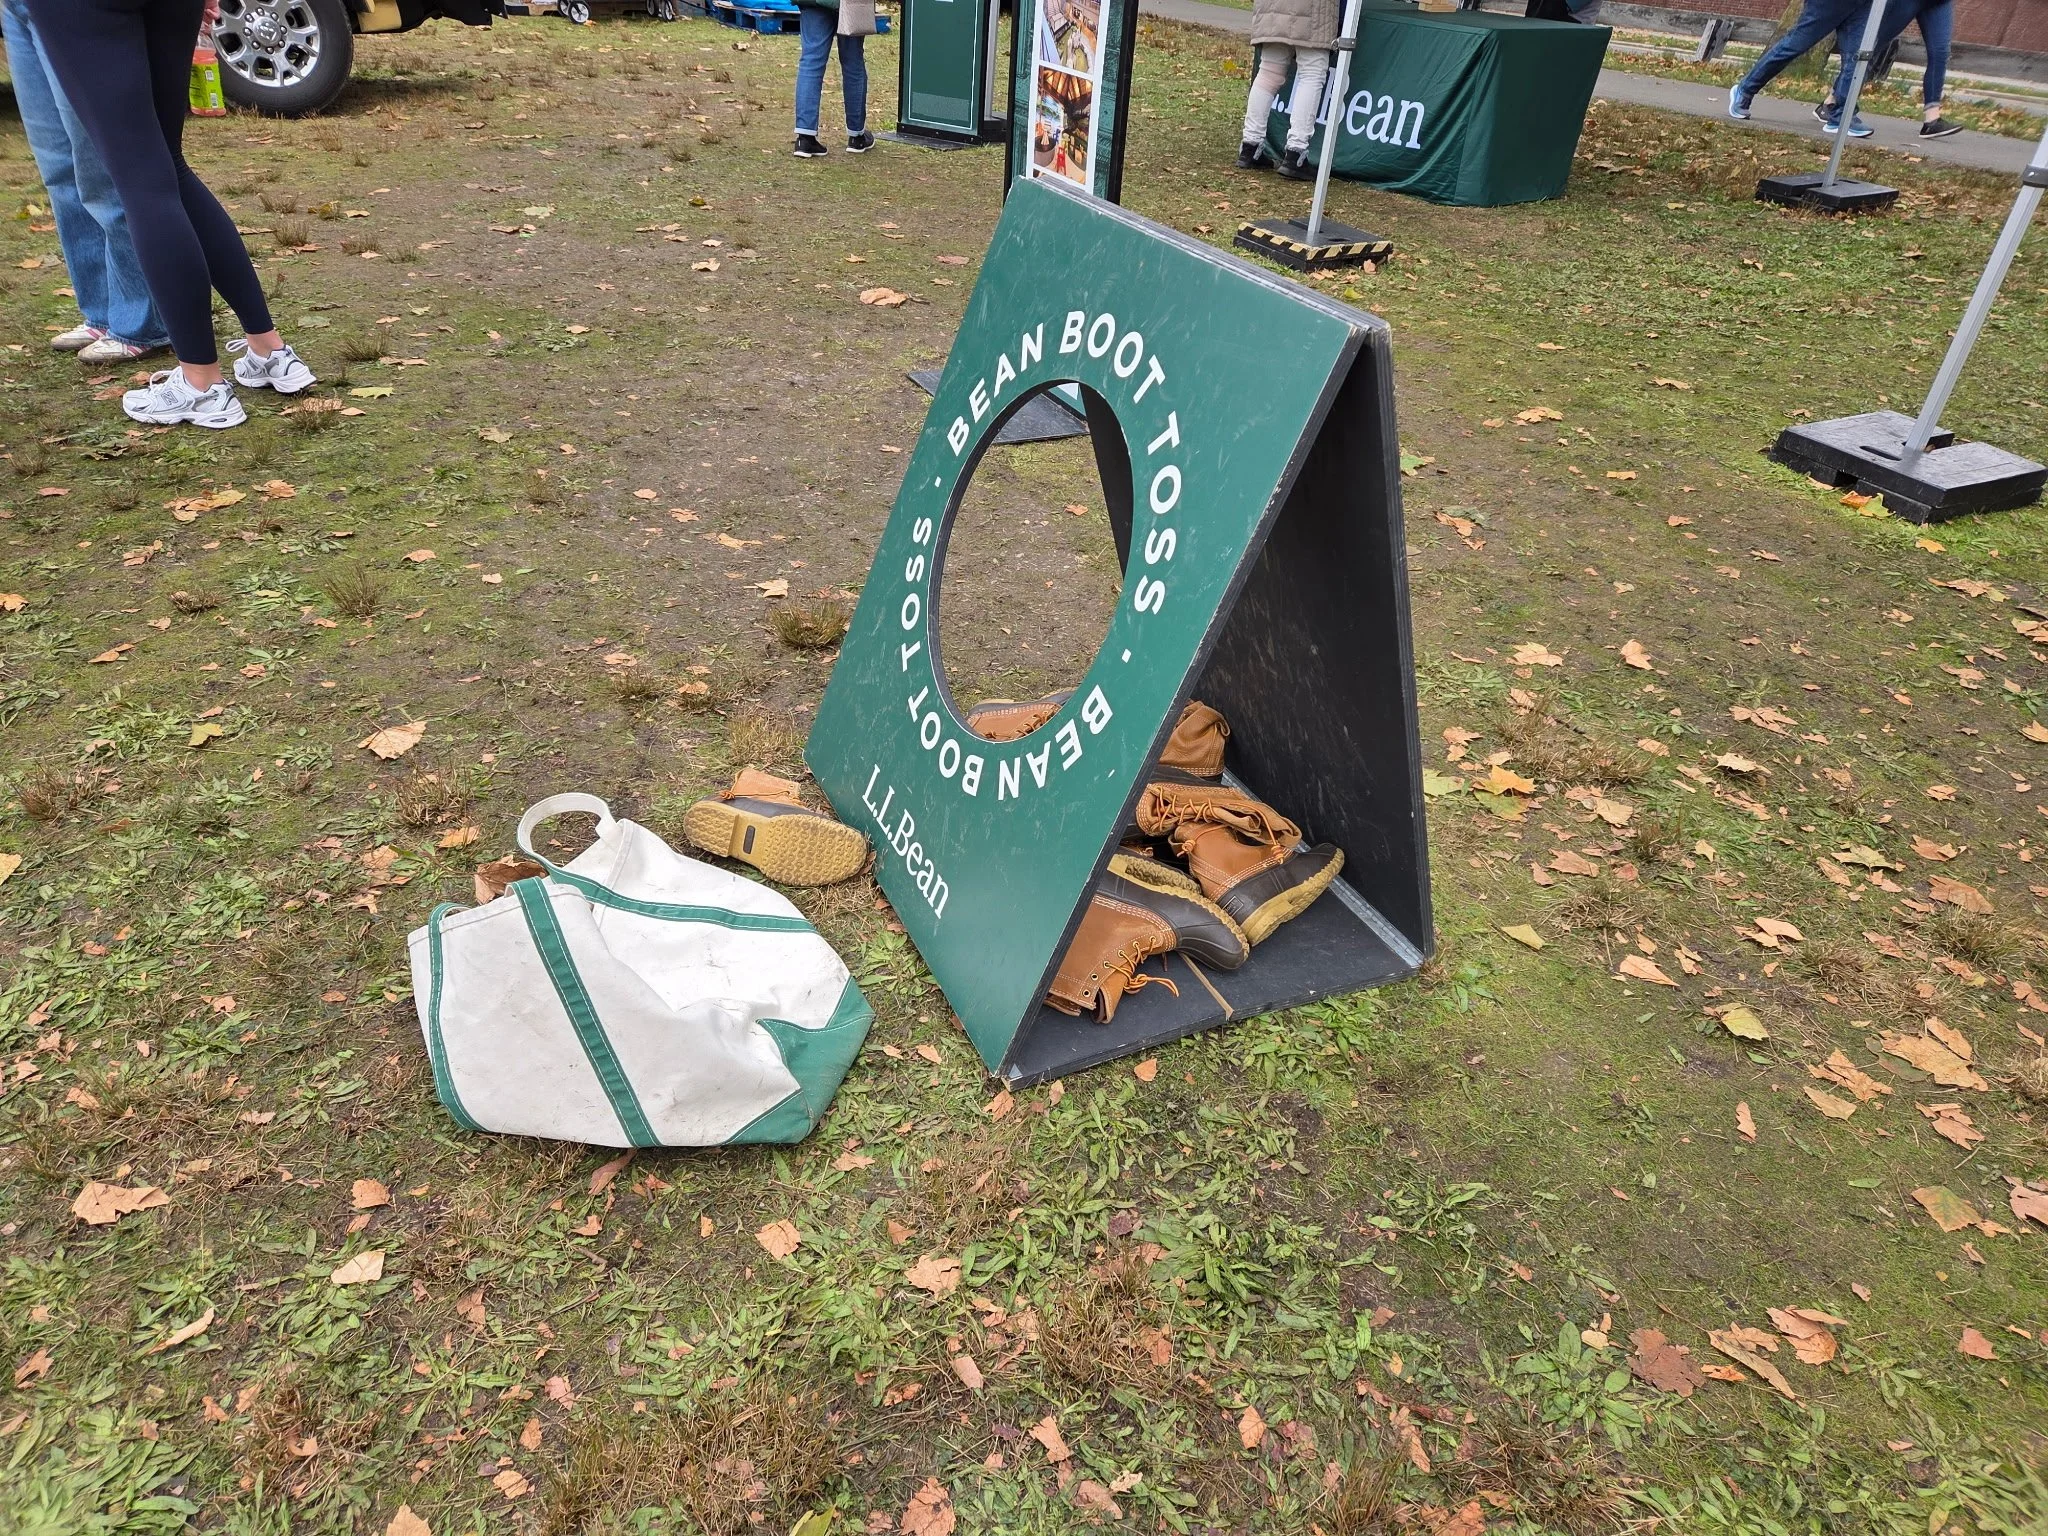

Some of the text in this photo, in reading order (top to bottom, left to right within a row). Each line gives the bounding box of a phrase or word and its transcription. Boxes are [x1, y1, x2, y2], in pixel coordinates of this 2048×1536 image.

[947, 310, 1181, 615] BEAN BOOT TOSS
[901, 516, 1113, 800] BEAN BOOT TOSS
[862, 764, 949, 919] L.L.Bean
